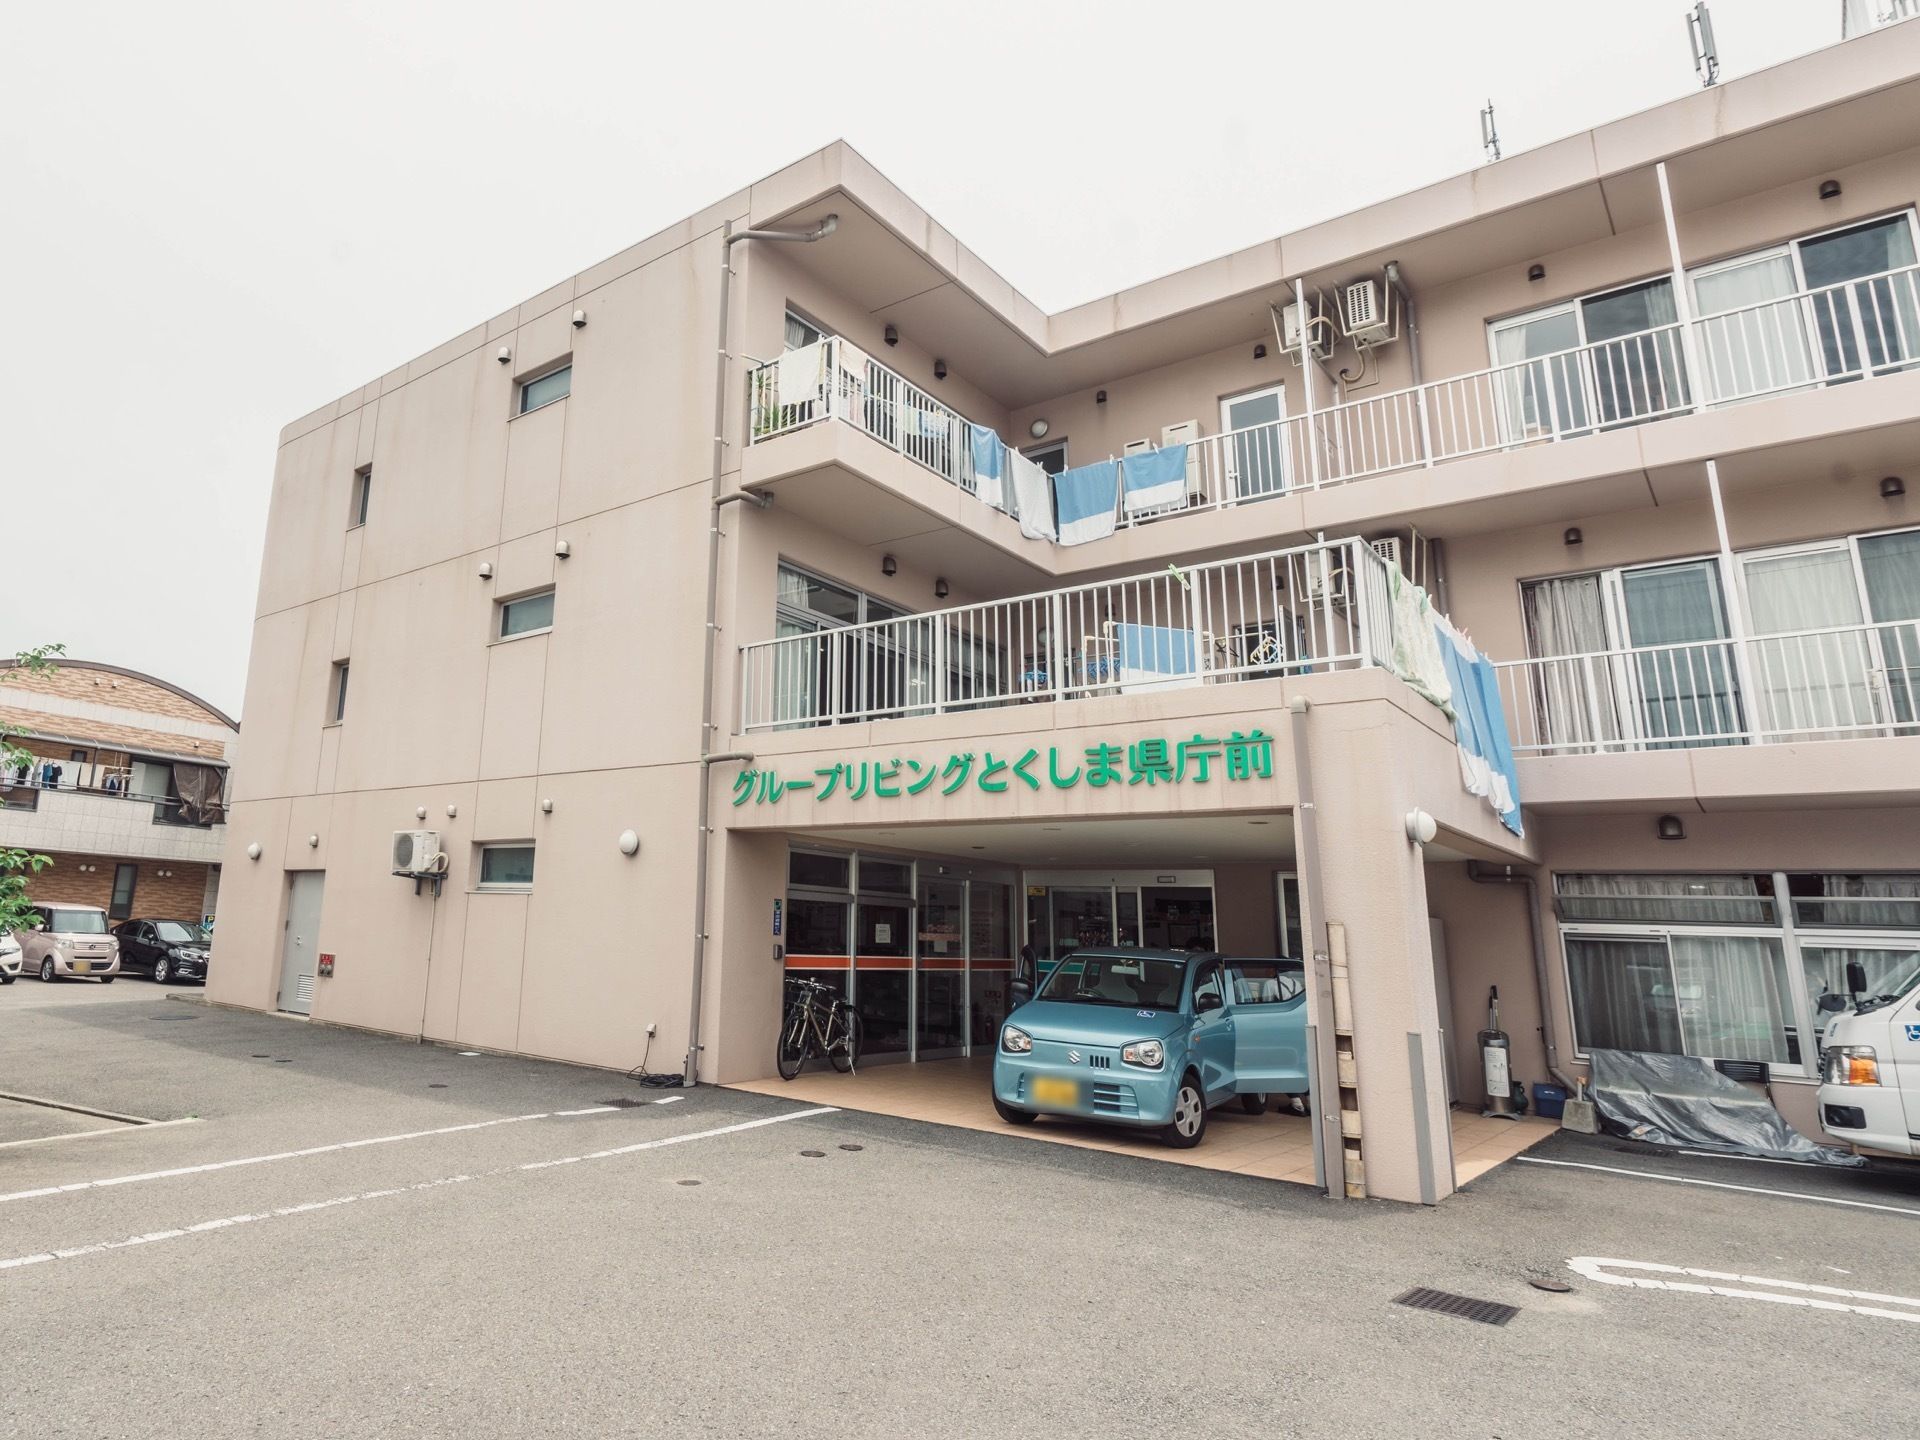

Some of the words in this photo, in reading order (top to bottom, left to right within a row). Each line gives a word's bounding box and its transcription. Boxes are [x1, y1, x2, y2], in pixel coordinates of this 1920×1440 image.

[733, 730, 1273, 806] グループリビングとくしま県庁前
